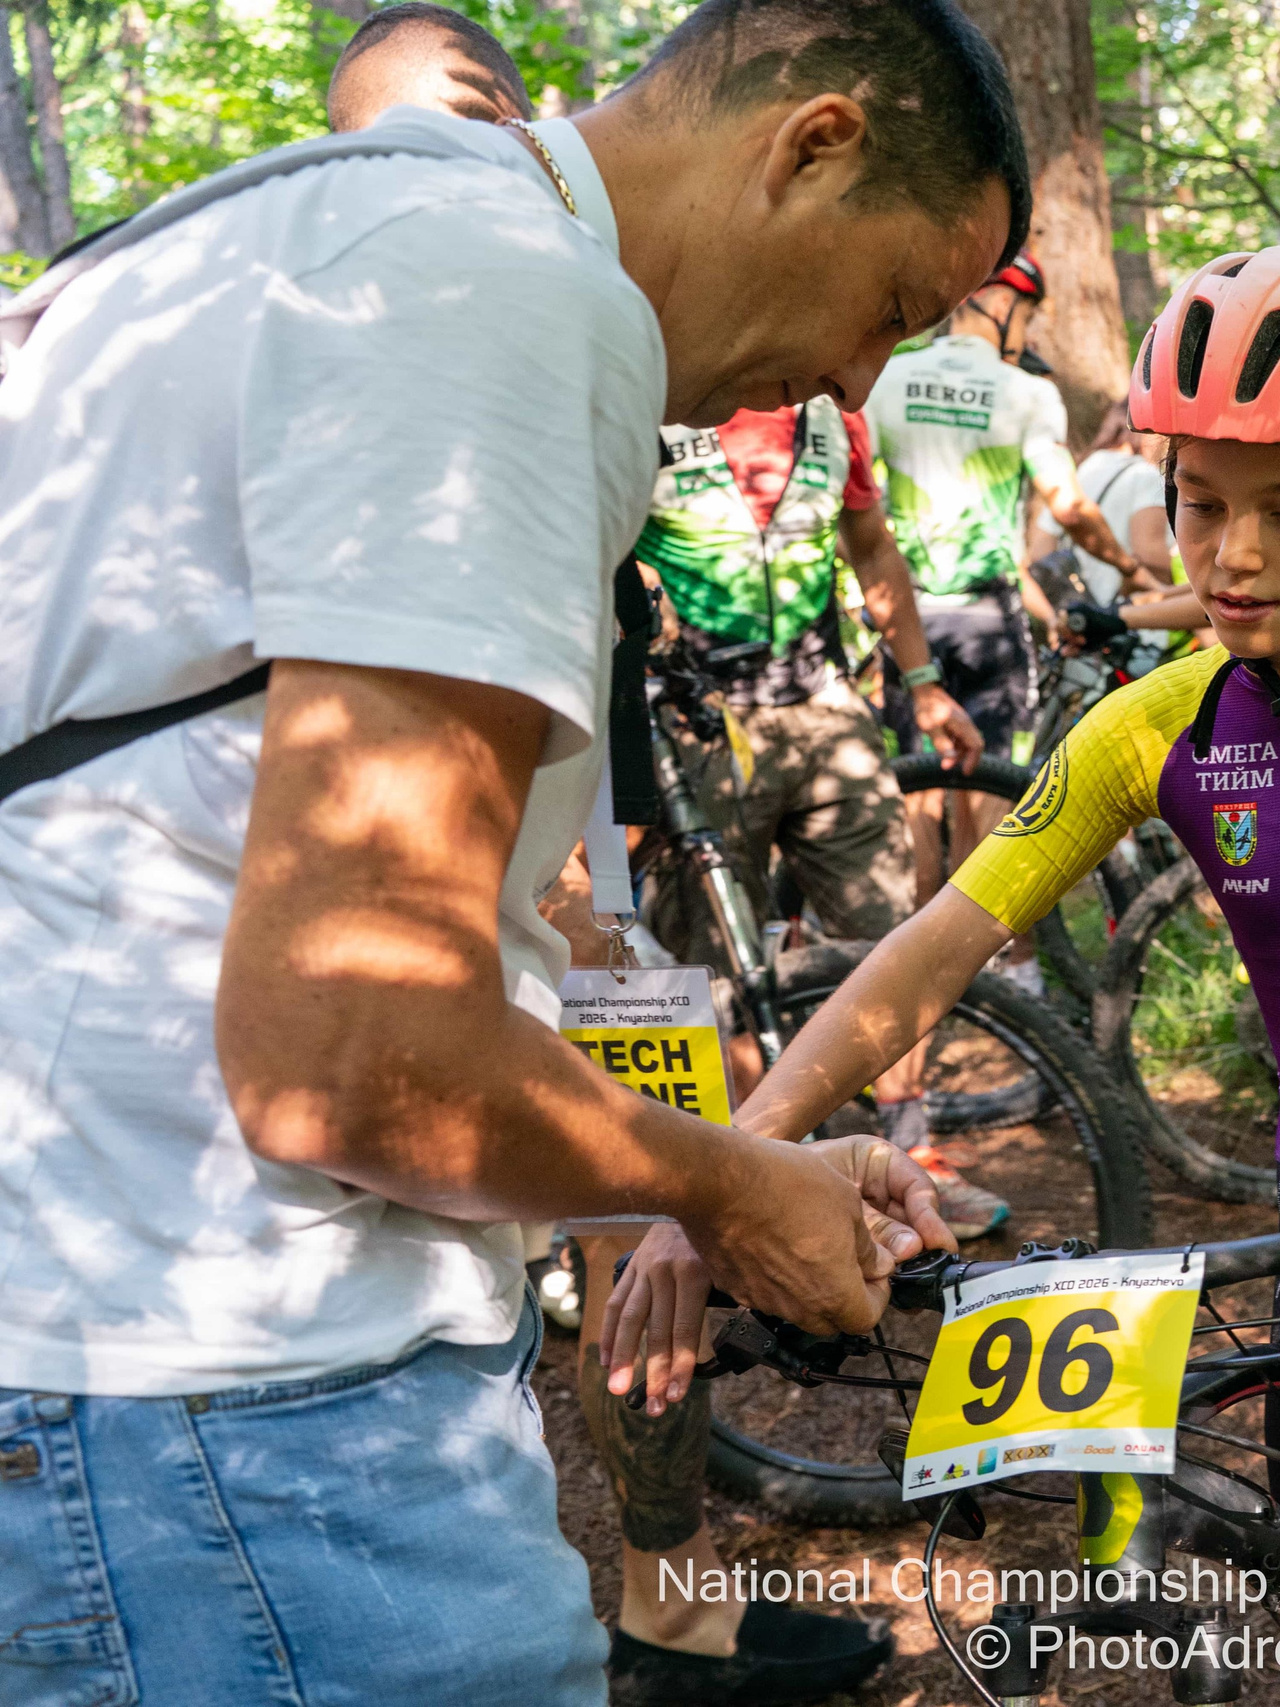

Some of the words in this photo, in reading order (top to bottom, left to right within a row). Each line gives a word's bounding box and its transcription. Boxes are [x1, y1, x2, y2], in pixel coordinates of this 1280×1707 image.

[906, 383, 994, 407] BEROE
[1196, 767, 1275, 792] ТИЙМ
[560, 997, 597, 1009] ational
[599, 996, 668, 1009] Championship
[579, 1013, 608, 1024] 2026
[617, 1012, 672, 1025] Knyazhevo
[574, 1039, 692, 1073] TECH
[954, 1294, 986, 1318] National
[985, 1282, 1051, 1307] Championship
[1078, 1278, 1110, 1290] 2026
[1121, 1276, 1184, 1290] Knyazhevo
[961, 1308, 1120, 1426] 96
